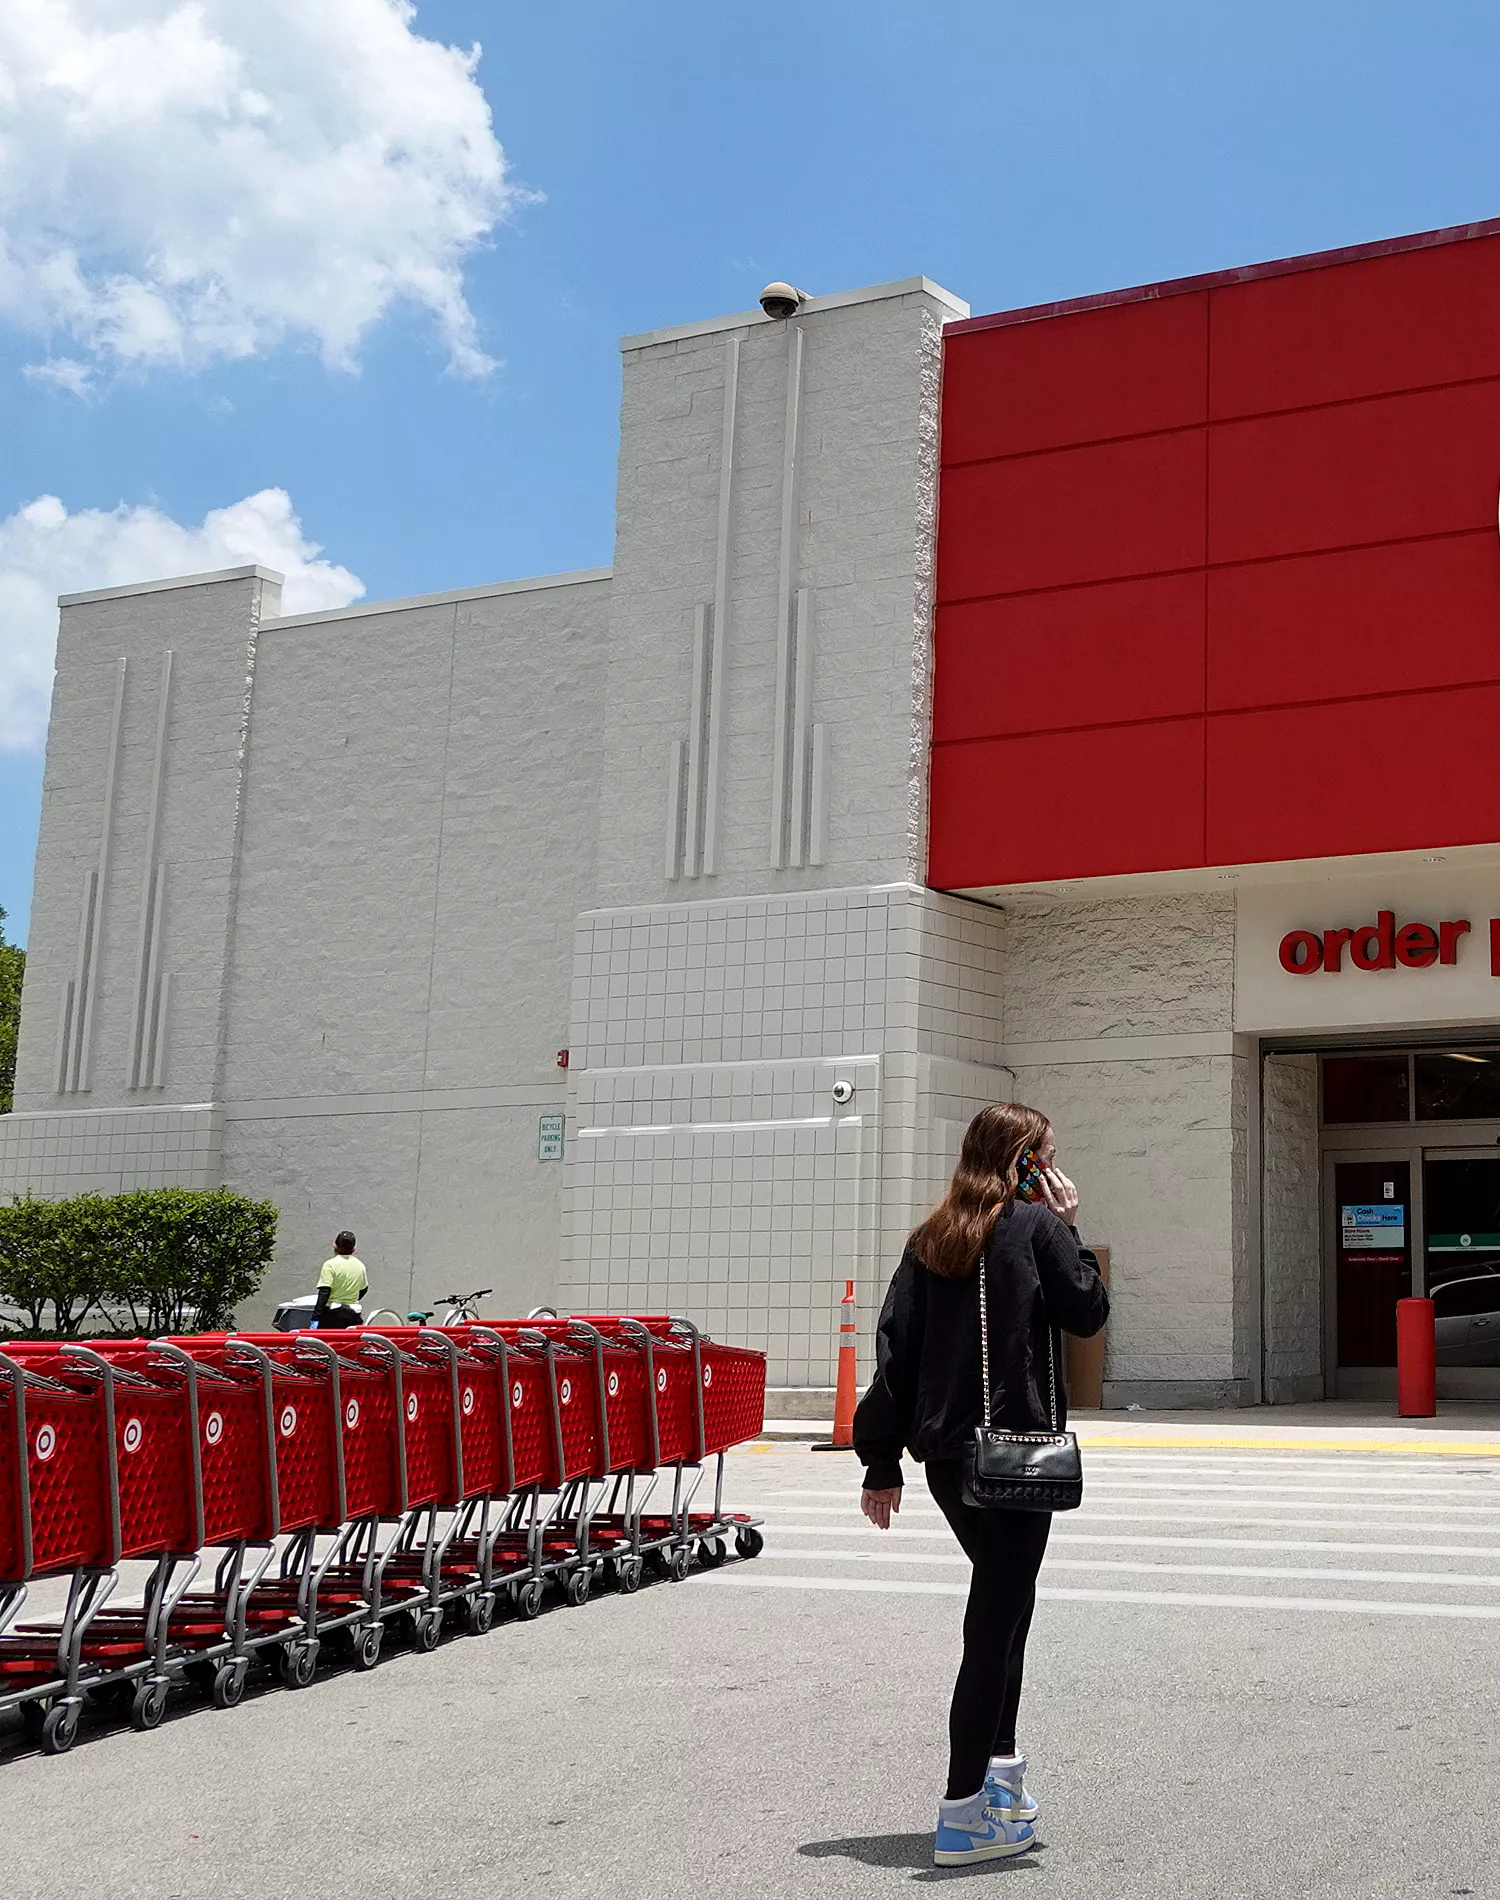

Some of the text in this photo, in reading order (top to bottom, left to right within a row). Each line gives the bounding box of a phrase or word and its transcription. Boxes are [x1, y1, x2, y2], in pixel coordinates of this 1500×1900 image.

[1278, 909, 1472, 975] order
[542, 1122, 560, 1130] BICYCLE
[541, 1134, 561, 1142] PARKING
